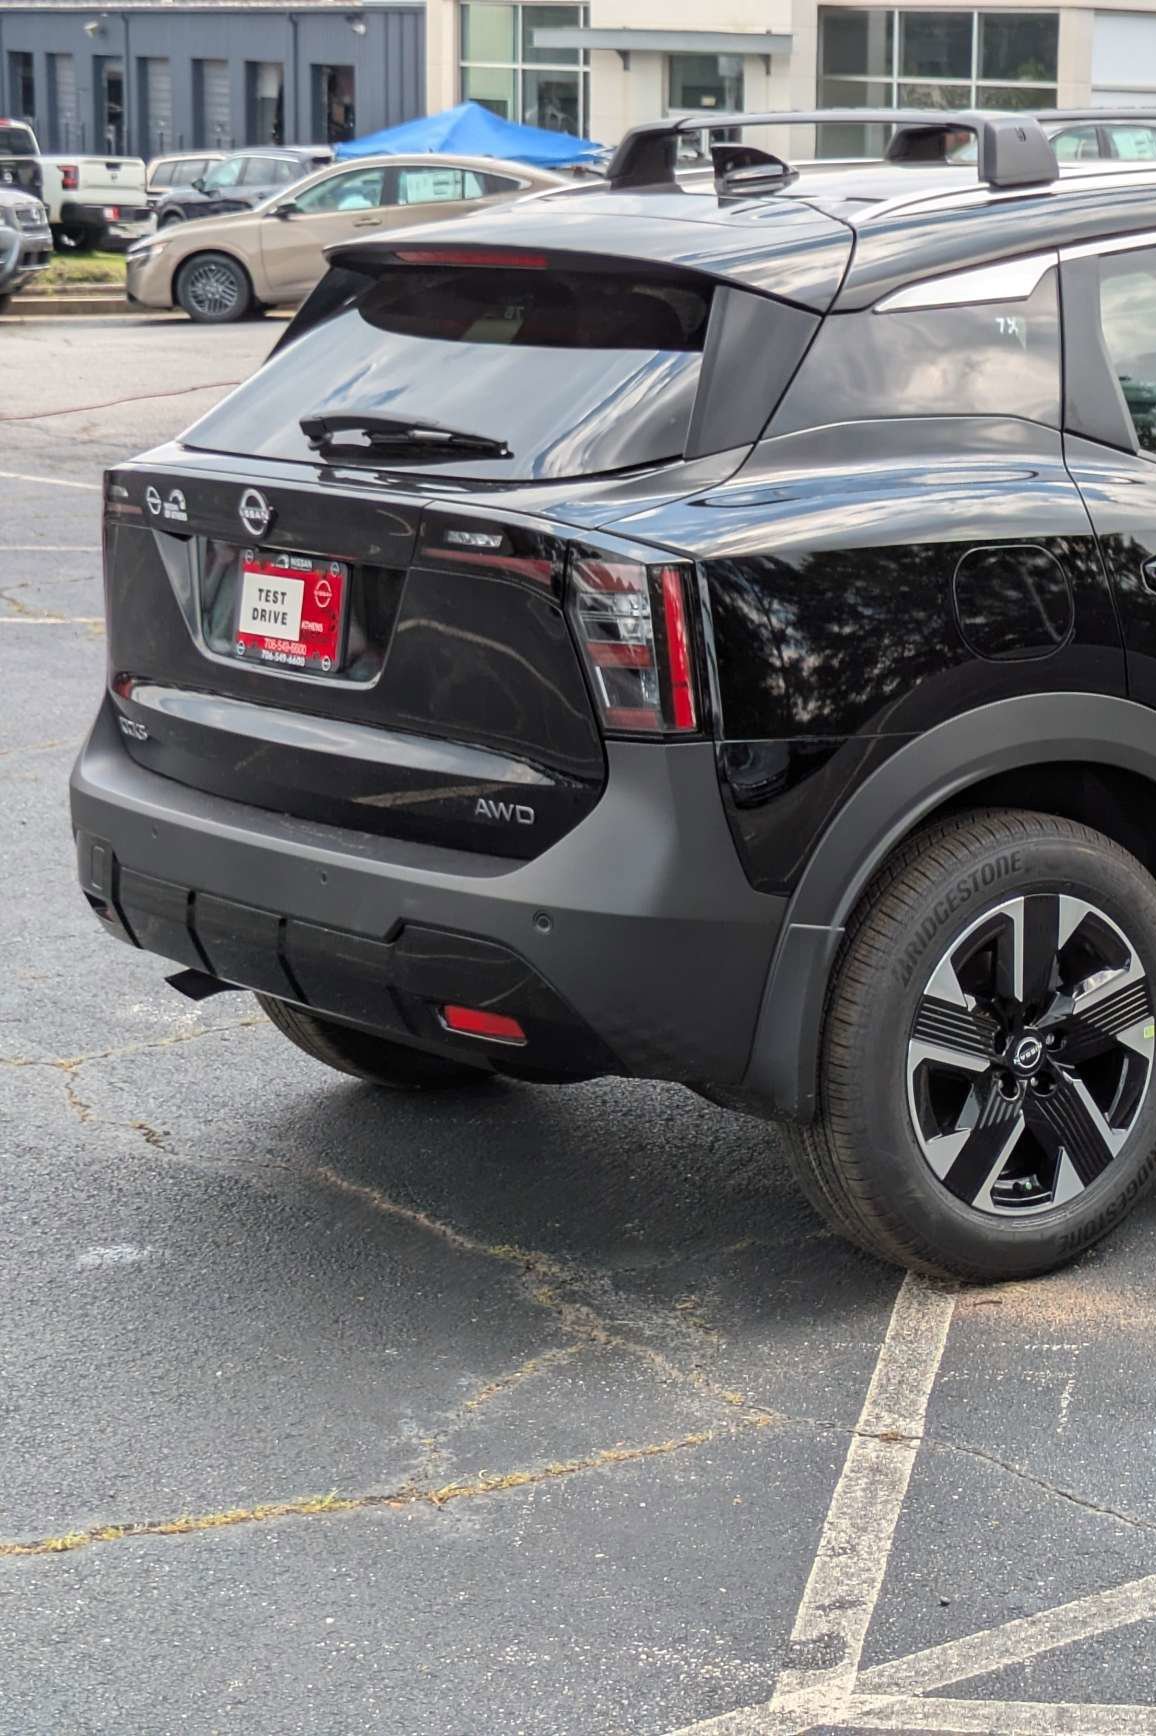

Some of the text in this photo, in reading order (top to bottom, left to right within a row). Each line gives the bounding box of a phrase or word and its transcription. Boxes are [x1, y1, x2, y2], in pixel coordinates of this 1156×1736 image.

[258, 588, 287, 605] TEST
[252, 607, 288, 626] DRIVE
[475, 798, 535, 824] AWD
[896, 850, 1022, 989] BRIDGESTONE
